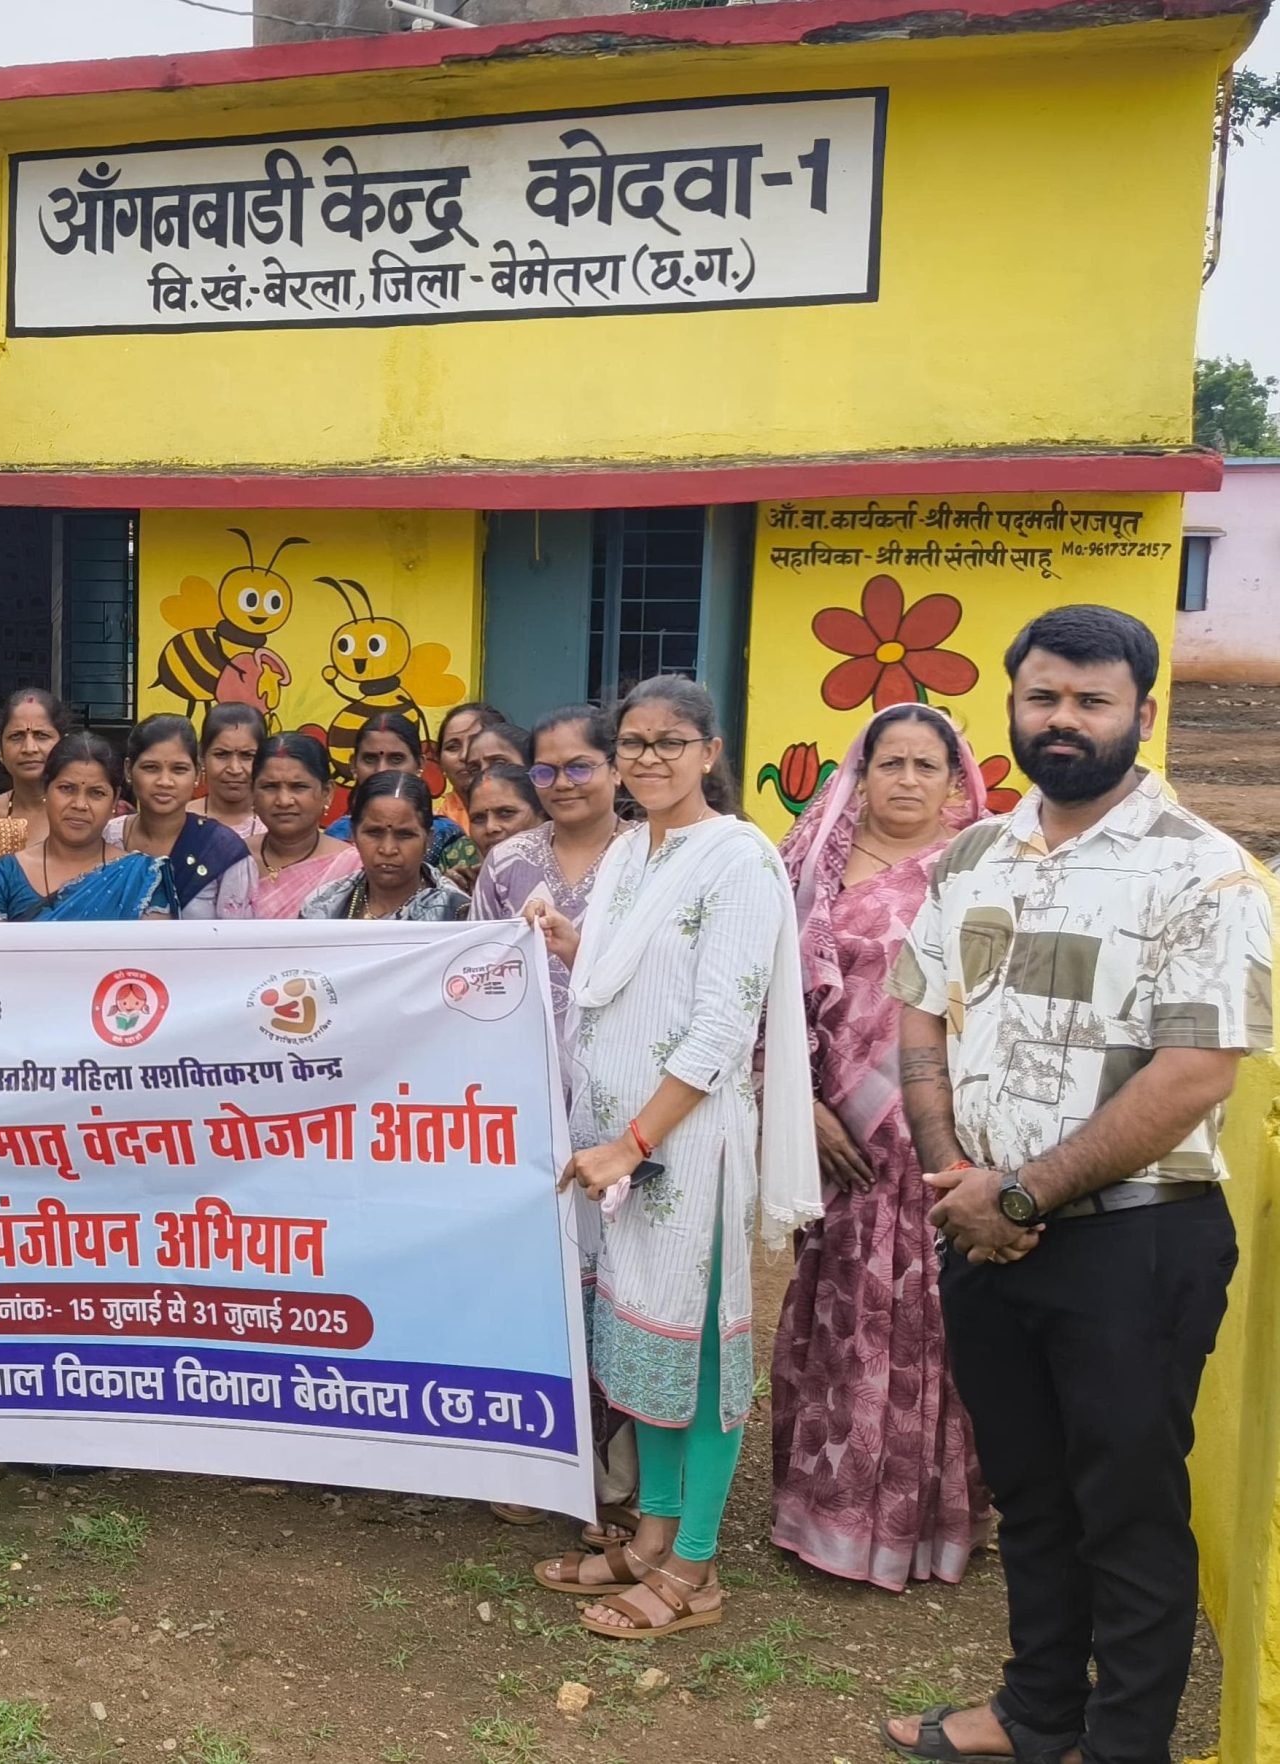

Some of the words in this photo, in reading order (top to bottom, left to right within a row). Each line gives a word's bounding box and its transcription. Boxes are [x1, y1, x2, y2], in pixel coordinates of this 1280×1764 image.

[321, 145, 478, 253] केन्द्र
[1070, 511, 1143, 540] राजपूत
[944, 540, 1008, 571] संतोषी
[1010, 549, 1062, 579] साहू
[62, 1059, 132, 1092] महिला
[138, 1056, 283, 1090] सशक्तिकरण
[287, 1052, 343, 1082] केन्द्र
[79, 1106, 196, 1166] वंदना
[204, 1103, 356, 1162] योजना
[372, 1083, 518, 1166] अंतर्गत
[155, 1198, 328, 1277] अभियान
[69, 1298, 95, 1321] 15
[101, 1290, 162, 1330] जुलाई
[167, 1291, 187, 1323] से
[193, 1301, 218, 1326] 31
[222, 1296, 283, 1335] जुलाई
[290, 1307, 348, 1334] 2025
[53, 1352, 165, 1401] विकास
[174, 1356, 282, 1409] विभाग
[291, 1364, 409, 1420] बेमेतरा
[422, 1380, 555, 1438] (छ.ग.)
